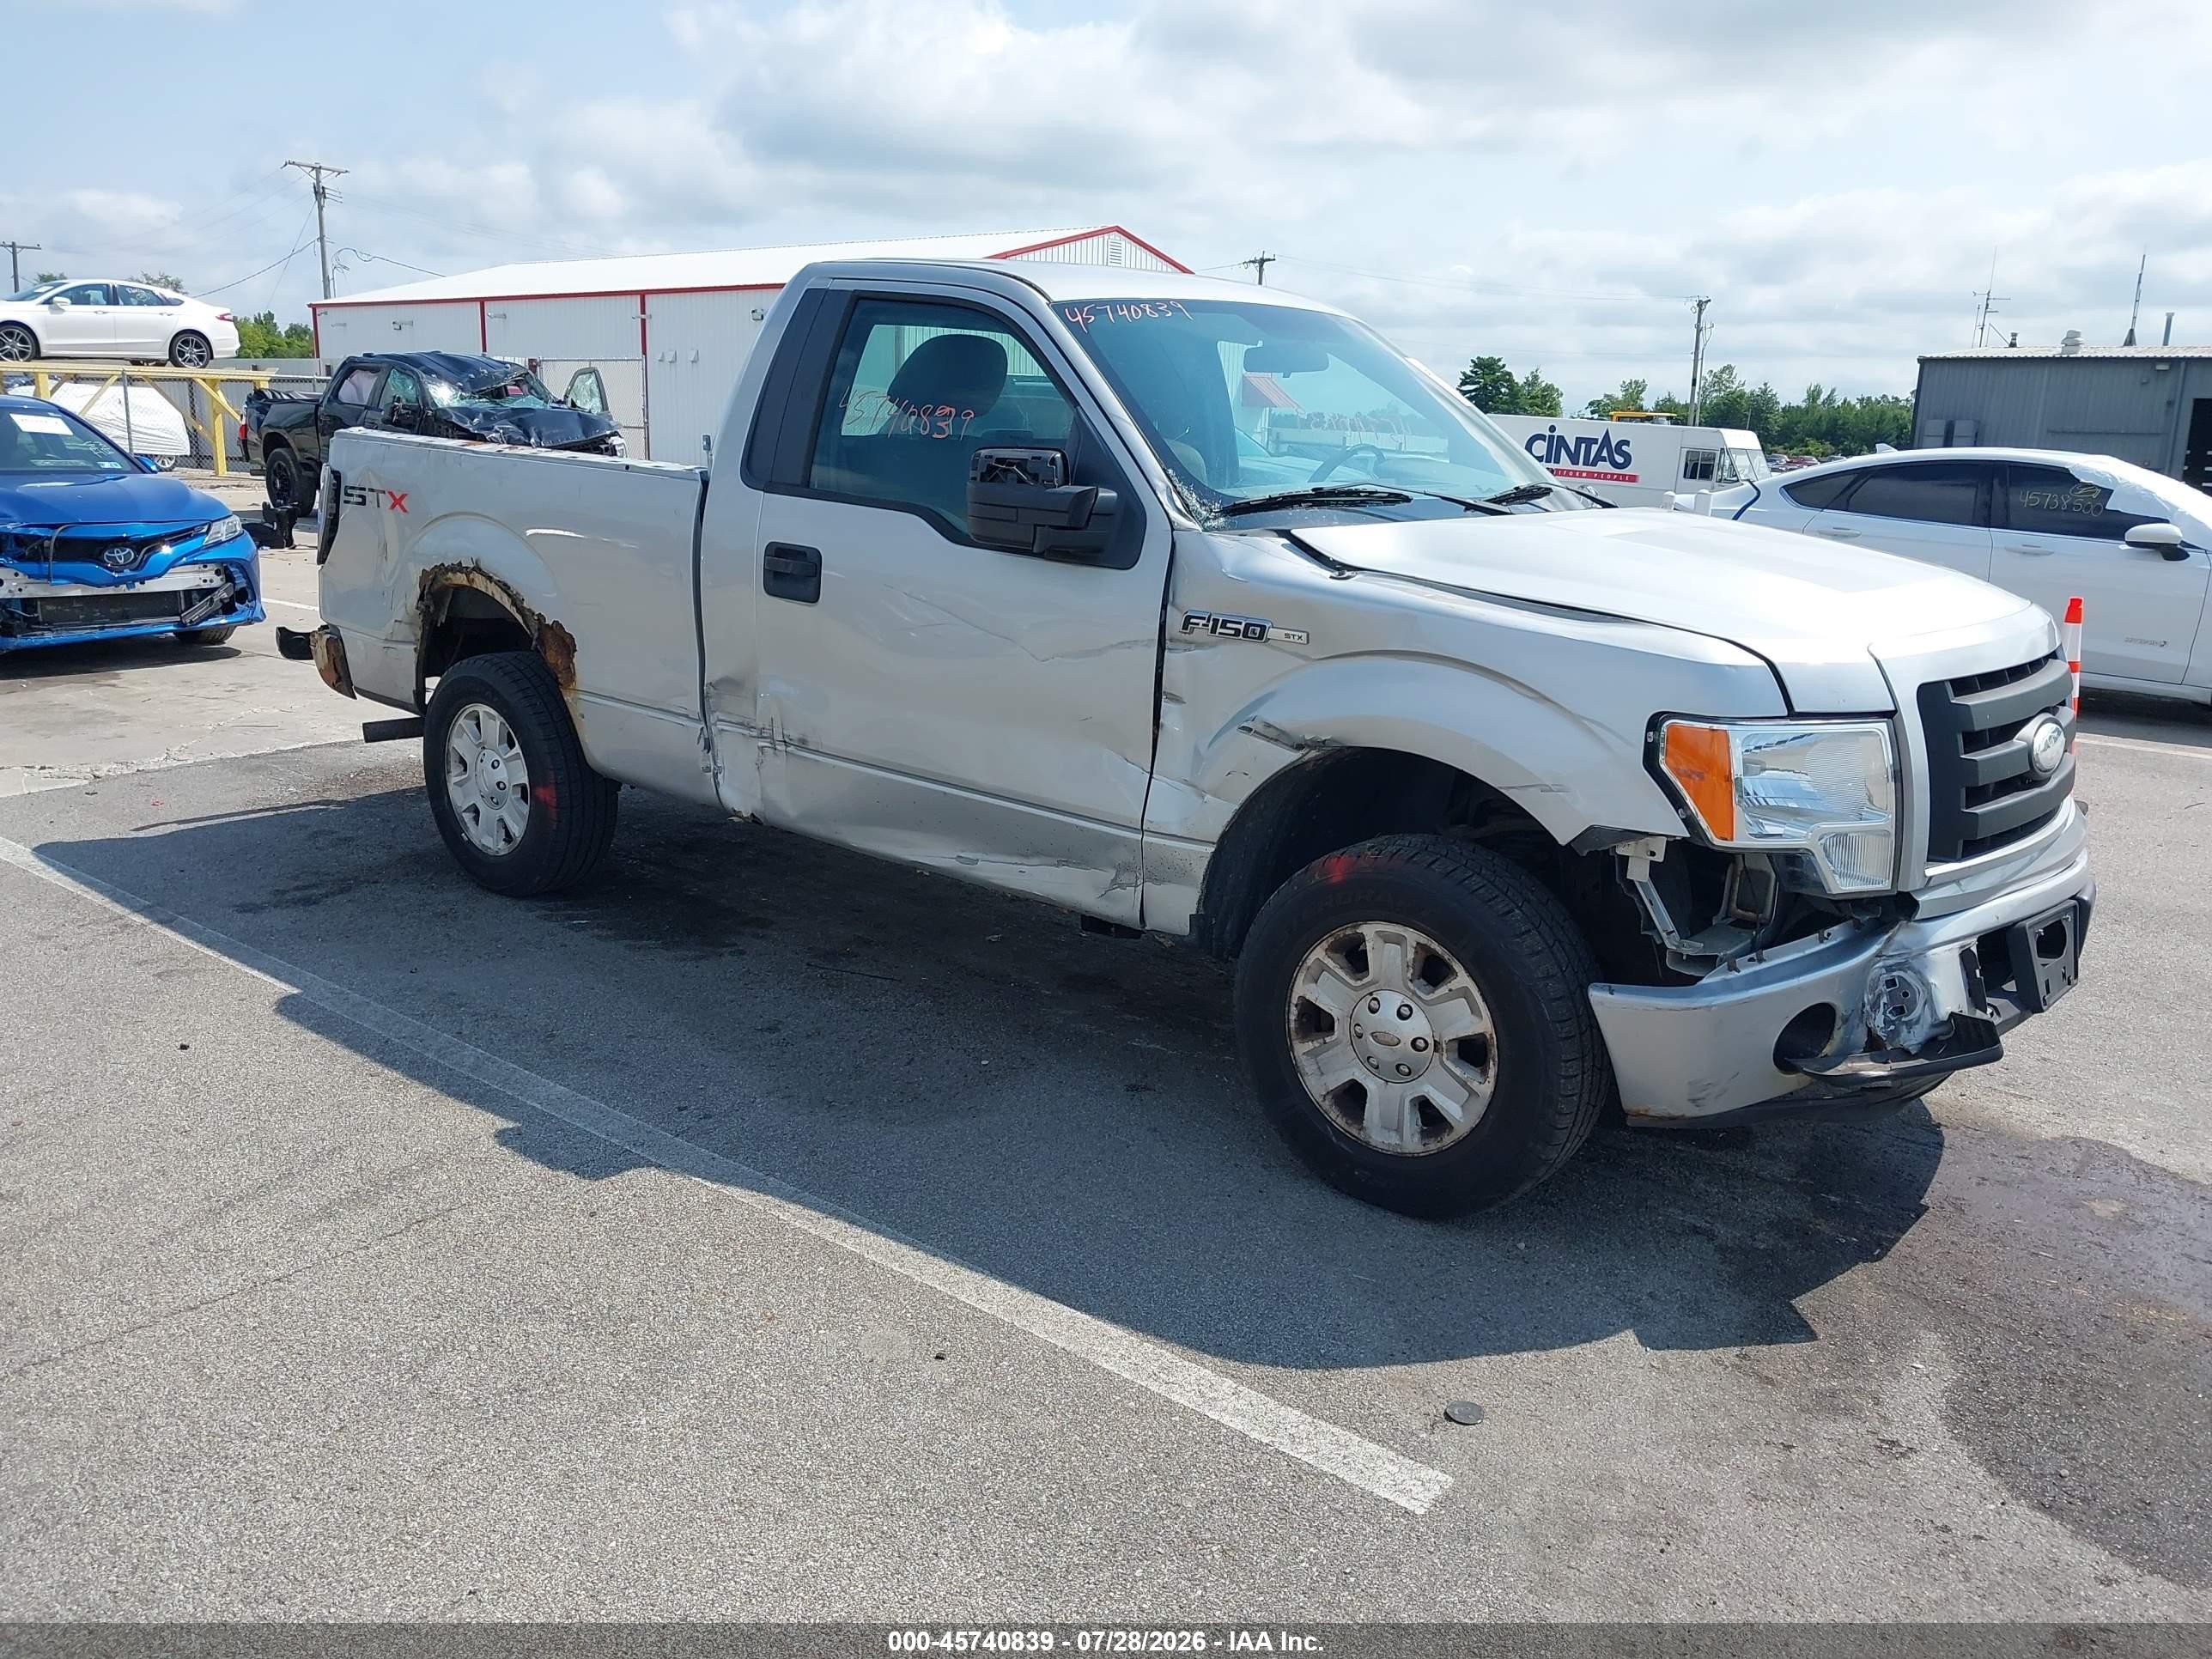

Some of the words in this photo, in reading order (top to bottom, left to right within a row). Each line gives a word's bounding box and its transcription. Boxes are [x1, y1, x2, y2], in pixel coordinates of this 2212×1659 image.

[1065, 301, 1194, 333] 45740839
[343, 485, 408, 514] STX
[2019, 489, 2104, 517] 45738500
[1284, 633, 1304, 641] STX
